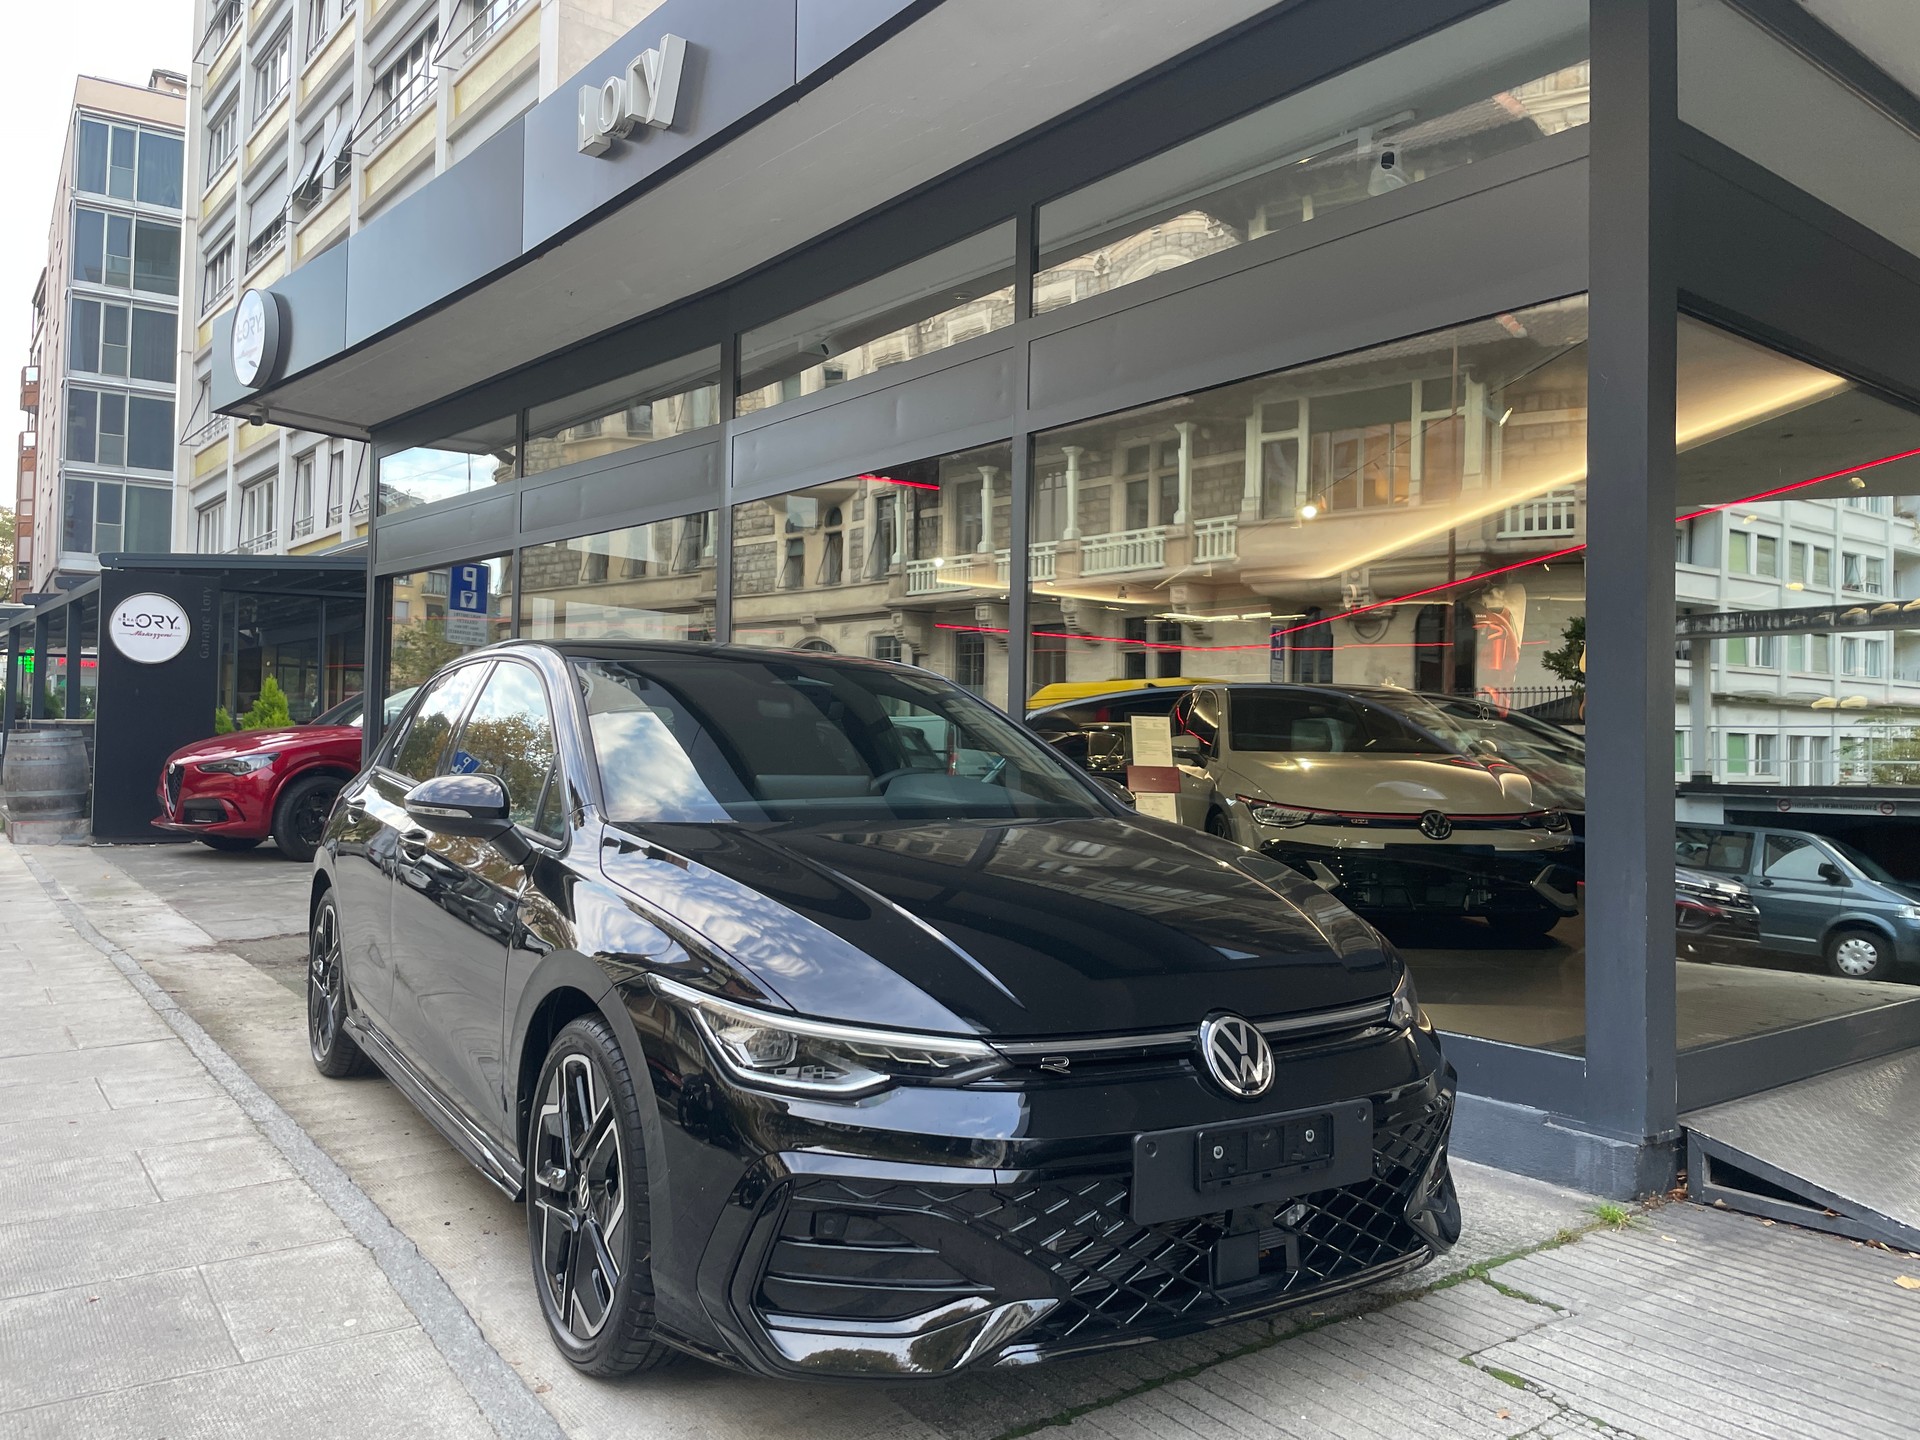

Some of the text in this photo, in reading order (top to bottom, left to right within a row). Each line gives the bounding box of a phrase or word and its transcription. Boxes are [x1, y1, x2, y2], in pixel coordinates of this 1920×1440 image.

[123, 613, 179, 629] LORY
[200, 586, 214, 659] Garage Lory
